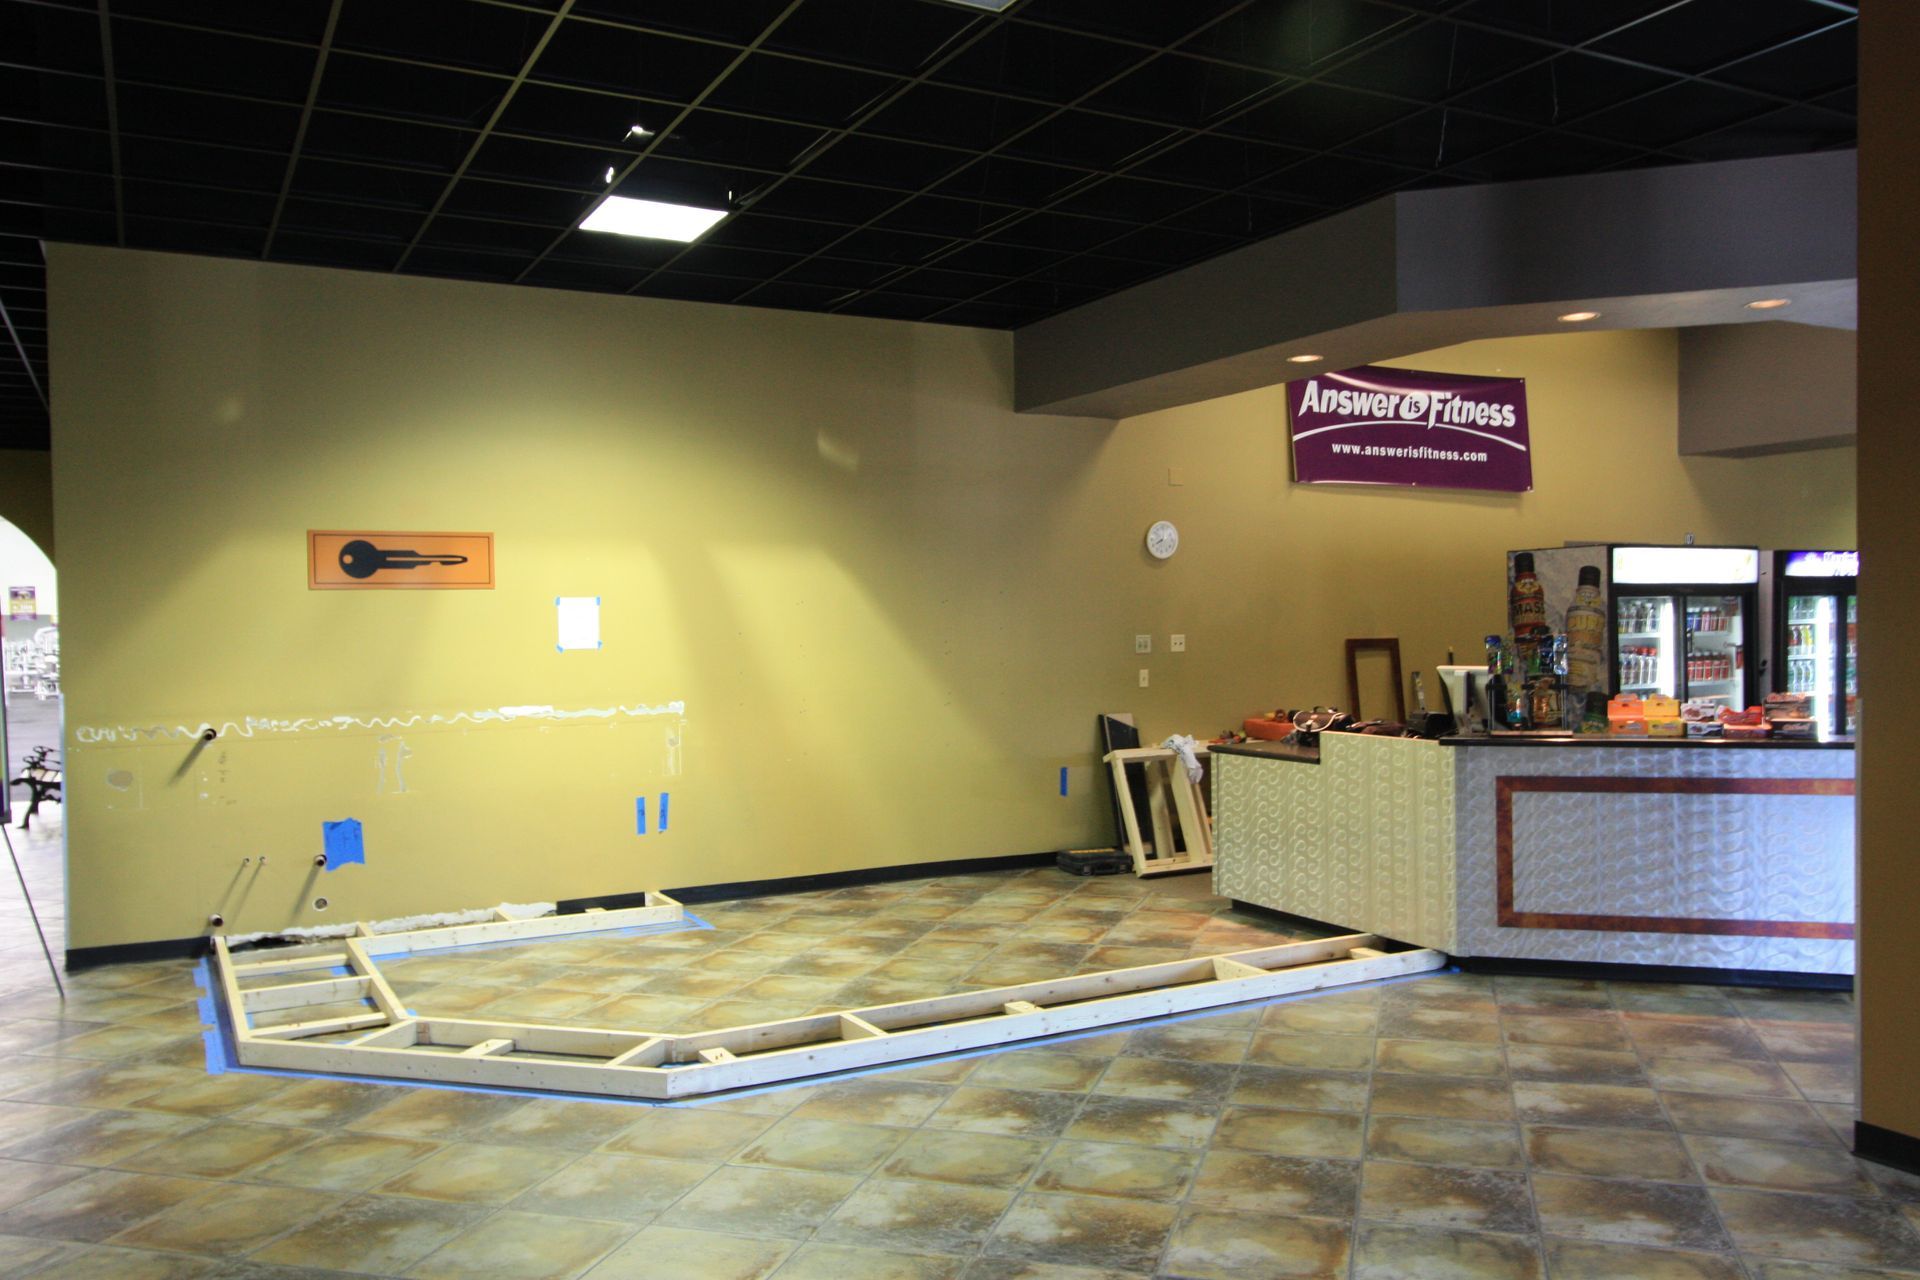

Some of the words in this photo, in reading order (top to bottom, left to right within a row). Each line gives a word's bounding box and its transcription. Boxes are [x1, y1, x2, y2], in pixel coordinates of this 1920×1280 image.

[1298, 380, 1402, 418] Answer
[1407, 396, 1422, 414] is
[1427, 391, 1516, 430] Fitness
[1331, 443, 1488, 462] www.answerisfitness.com
